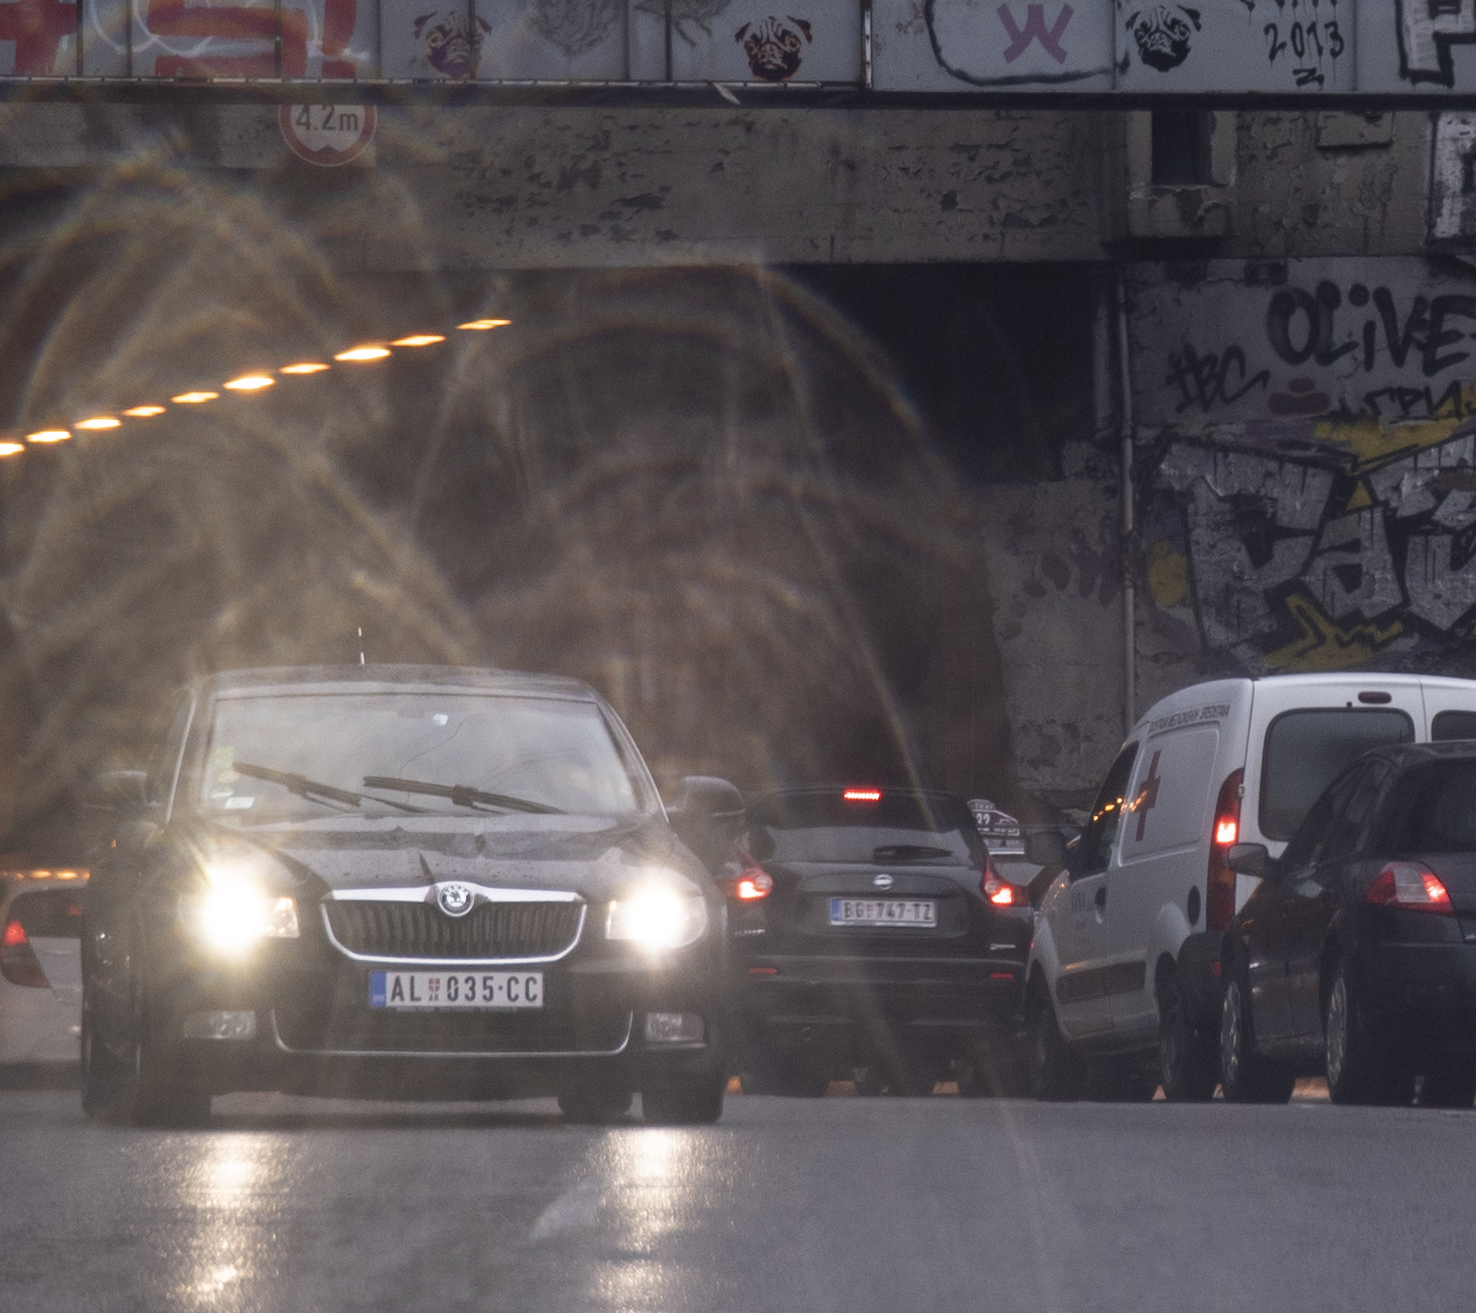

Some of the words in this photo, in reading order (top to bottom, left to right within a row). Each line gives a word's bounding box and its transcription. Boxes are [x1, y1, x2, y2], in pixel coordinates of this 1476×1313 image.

[1263, 19, 1345, 62] 2013
[843, 902, 864, 919] BG
[390, 975, 422, 1002] AL
